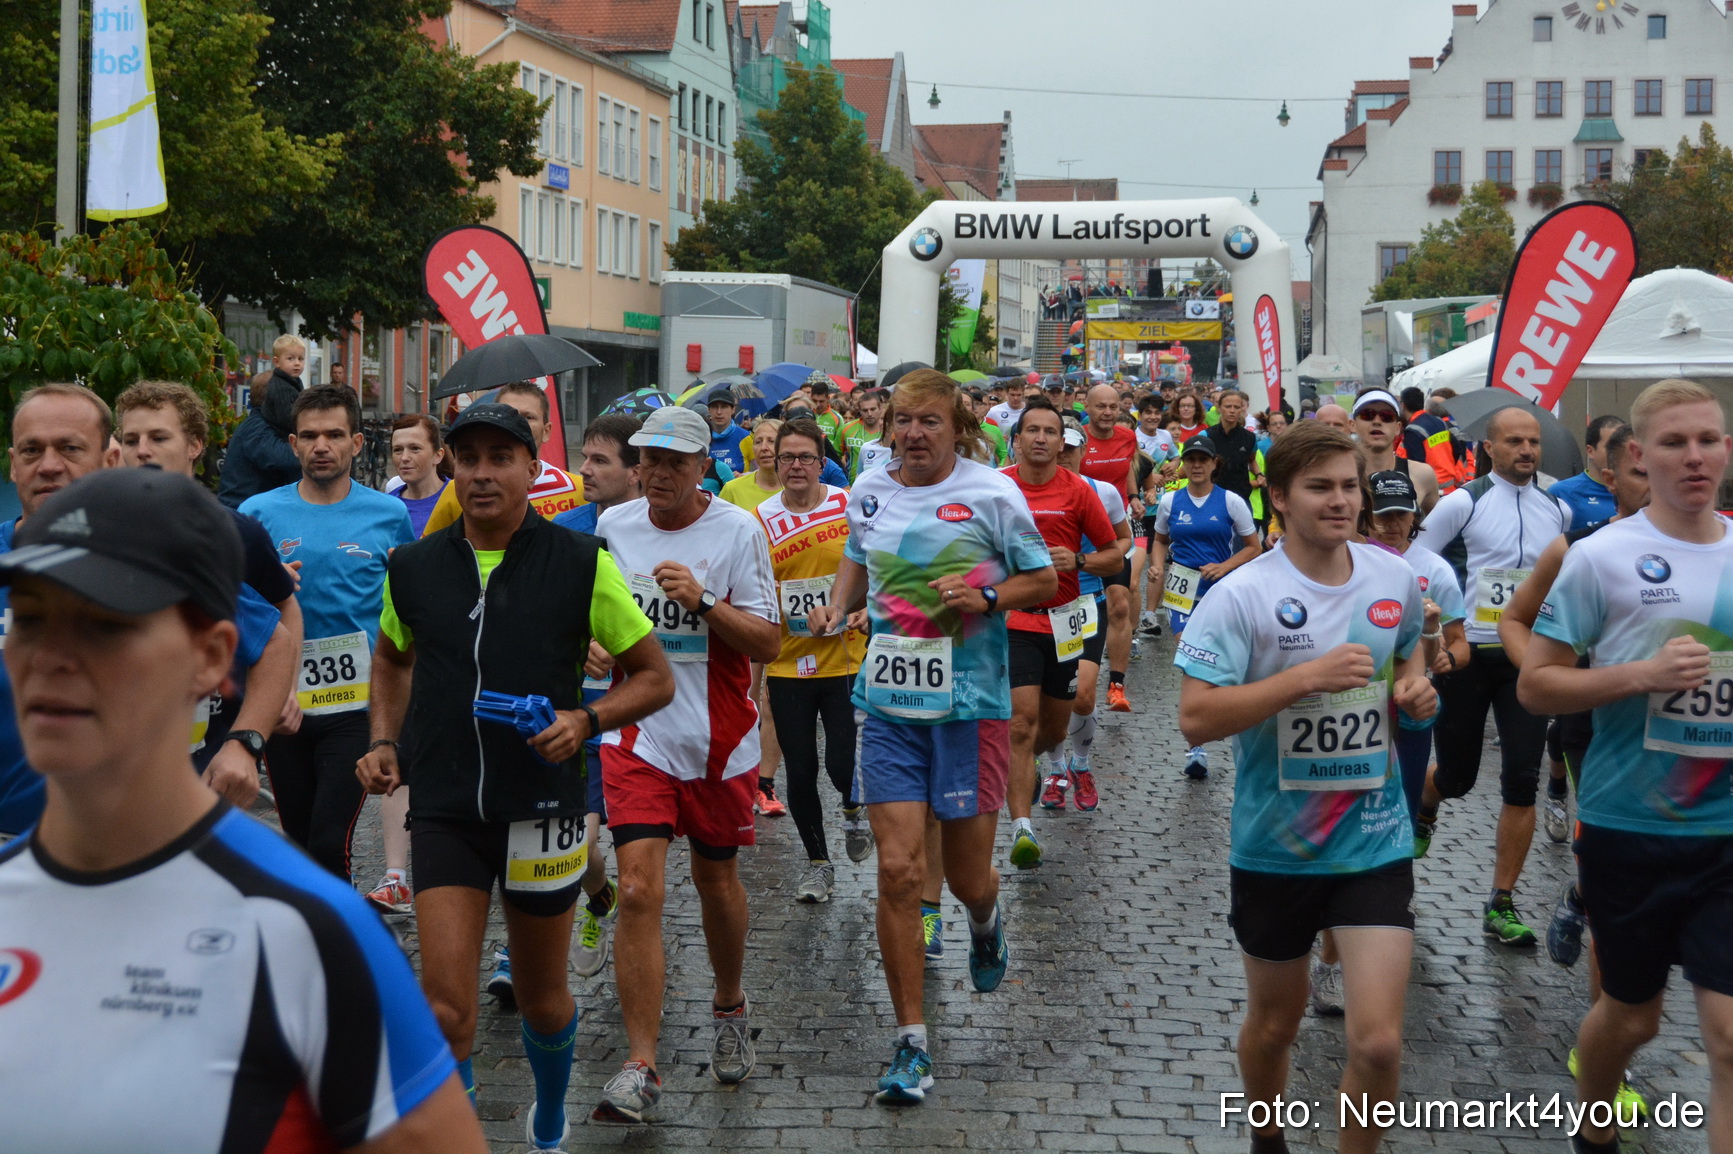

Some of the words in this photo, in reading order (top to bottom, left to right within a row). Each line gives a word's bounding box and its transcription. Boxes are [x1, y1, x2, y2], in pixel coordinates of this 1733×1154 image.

[954, 213, 1043, 240] BMW
[1052, 213, 1211, 244] Laufsport
[1501, 229, 1617, 405] REWE
[1139, 325, 1169, 337] ZIEL
[774, 536, 812, 565] MAX
[815, 525, 850, 544] BÖG
[1640, 587, 1680, 599] PARTL
[1641, 596, 1681, 606] Neumarkt
[1371, 606, 1402, 621] Hervis
[1278, 633, 1315, 645] PARTL
[1279, 642, 1316, 652] Neumarkt
[303, 653, 357, 686] 338
[874, 655, 944, 688] 2616
[311, 690, 356, 705] Andreas
[890, 693, 924, 707] Achim
[1291, 708, 1382, 753] 2622
[1683, 726, 1732, 743] Martin
[1309, 762, 1370, 777] Andreas
[533, 851, 582, 878] Matthias
